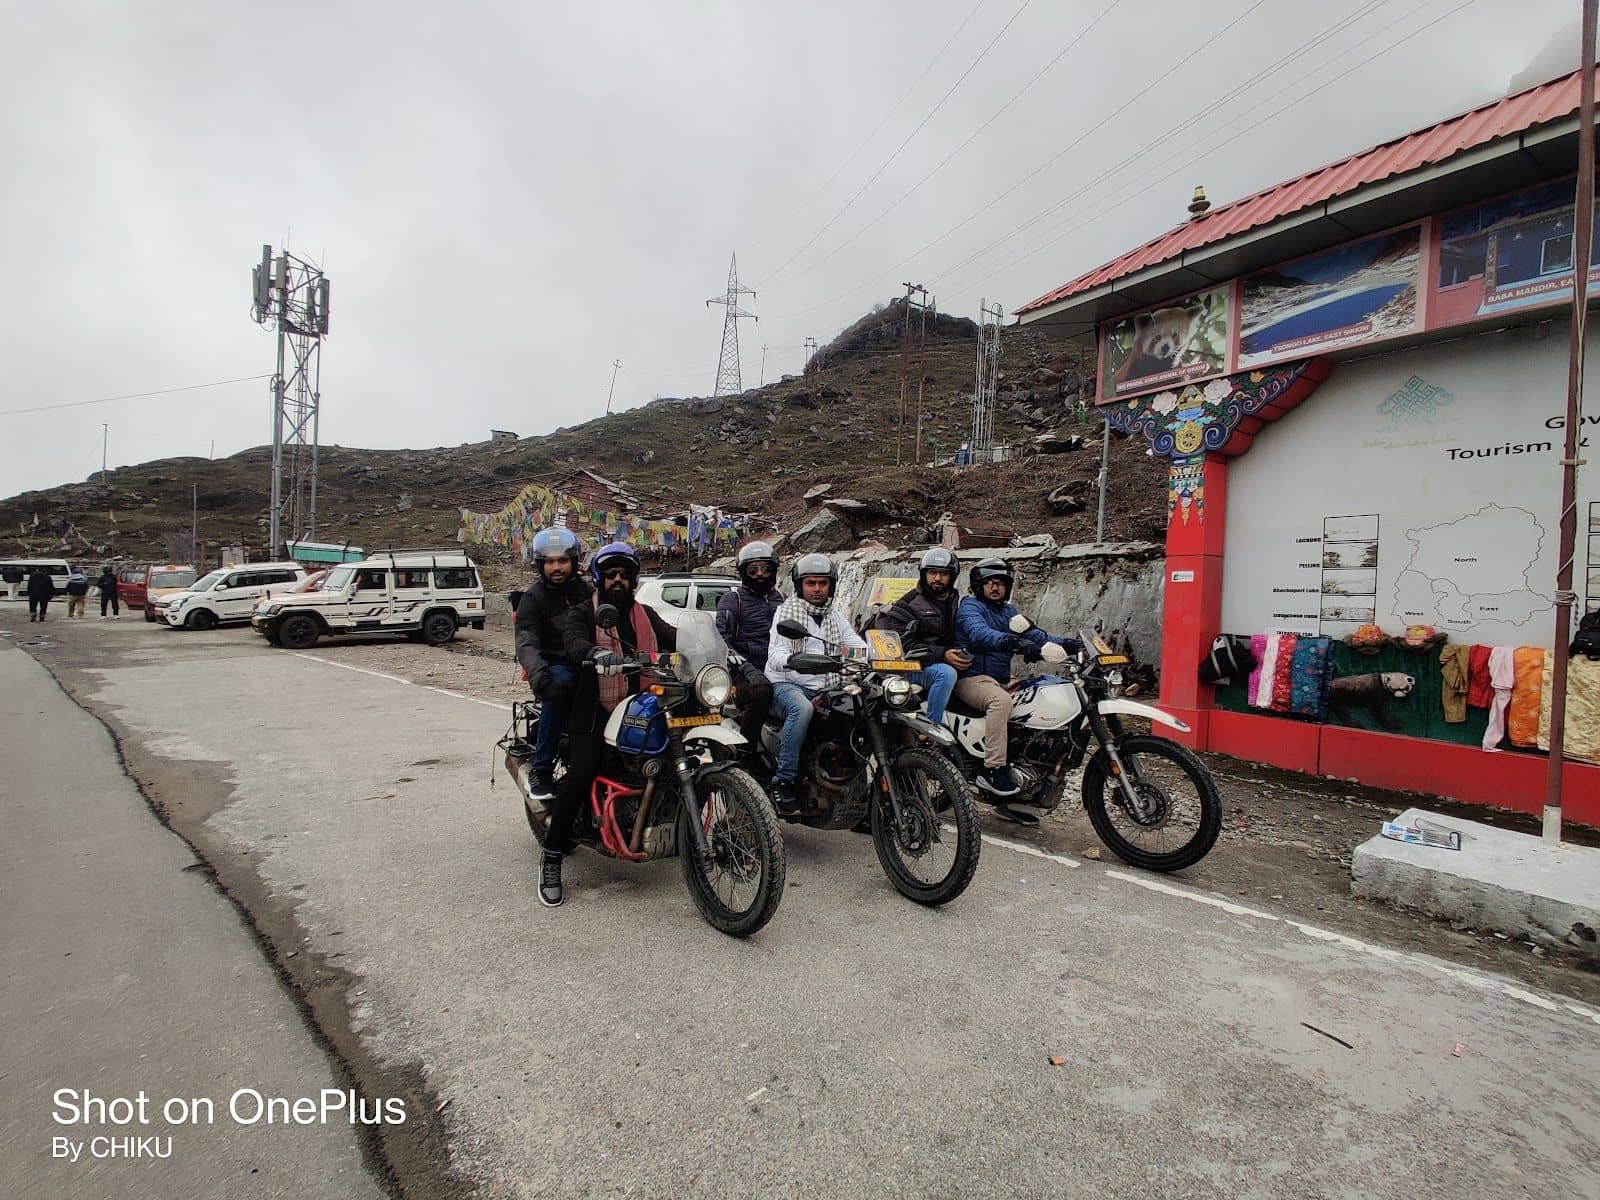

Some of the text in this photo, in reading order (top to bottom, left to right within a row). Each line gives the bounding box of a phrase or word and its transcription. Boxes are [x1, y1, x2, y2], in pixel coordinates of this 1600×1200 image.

[1487, 291, 1514, 303] BABA
[1343, 324, 1370, 336] SIKKIM
[1446, 441, 1552, 460] Tourism
